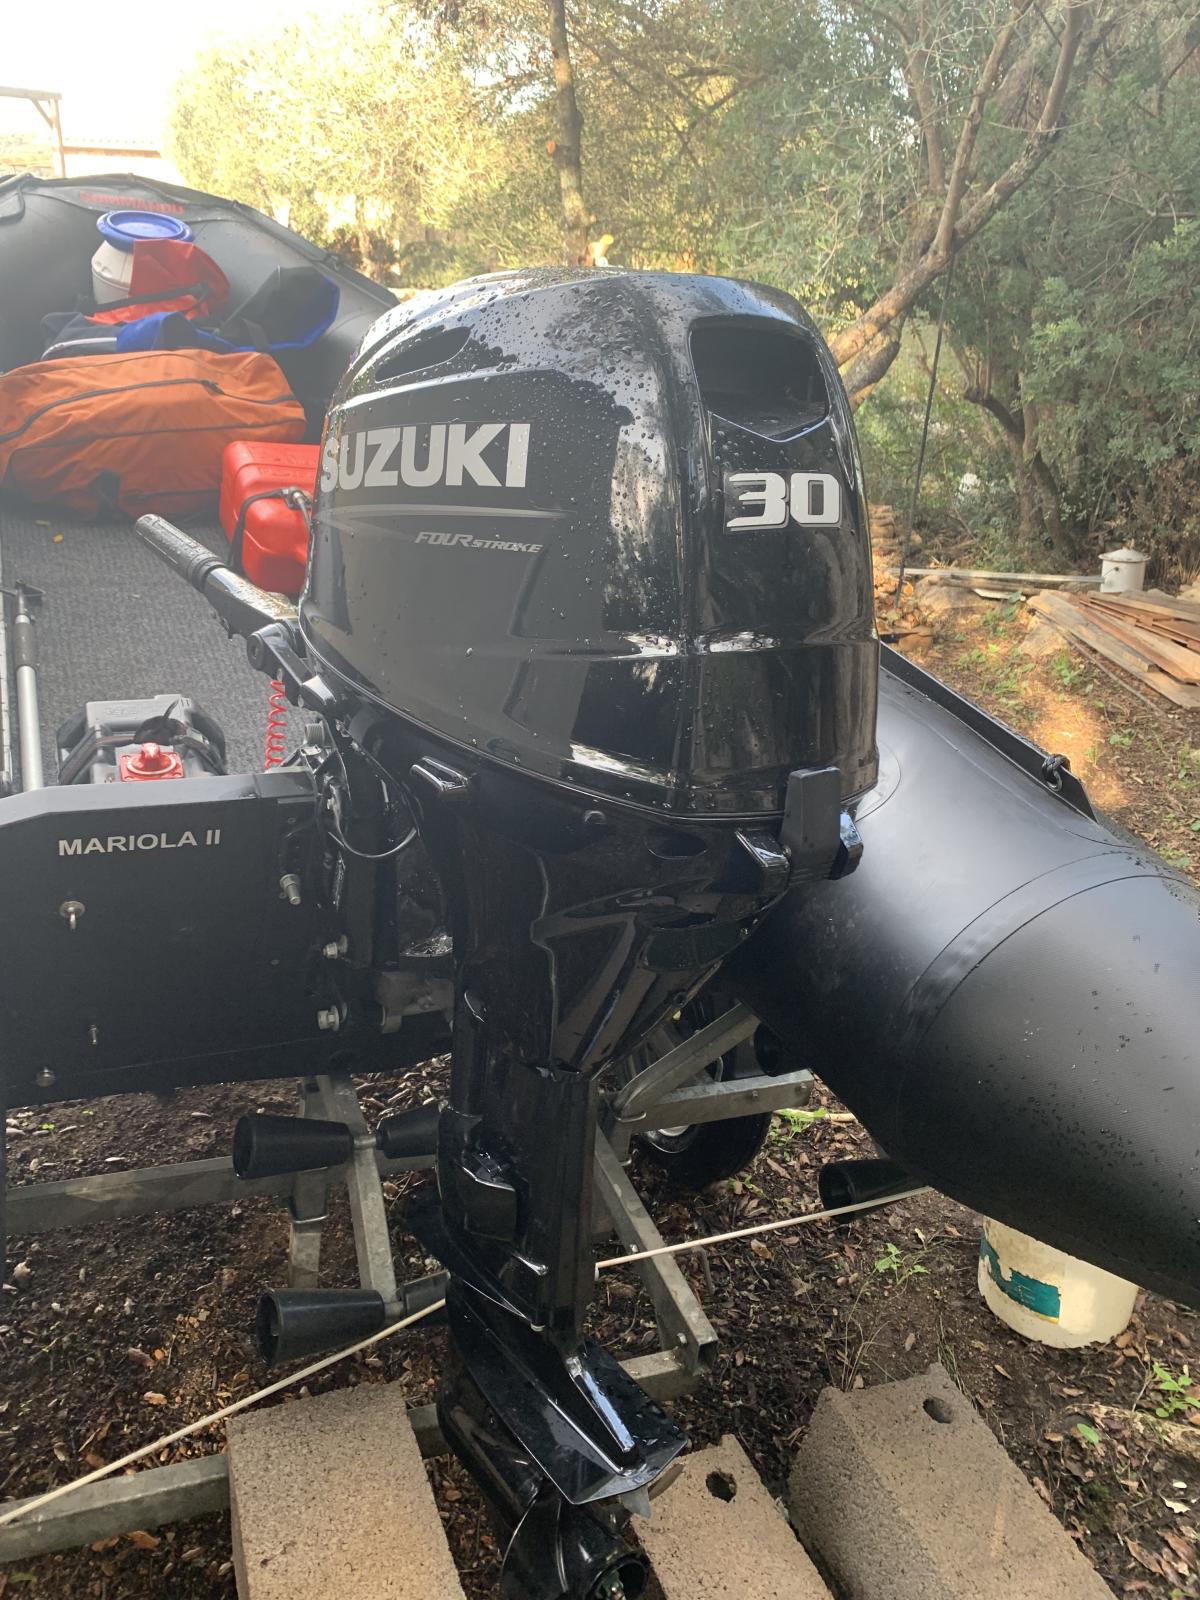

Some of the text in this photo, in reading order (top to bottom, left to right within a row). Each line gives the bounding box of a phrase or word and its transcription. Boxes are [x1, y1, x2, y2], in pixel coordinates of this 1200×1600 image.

[320, 423, 531, 493] SUZUKI
[726, 472, 842, 531] 30
[58, 829, 221, 856] MARIOLA II
